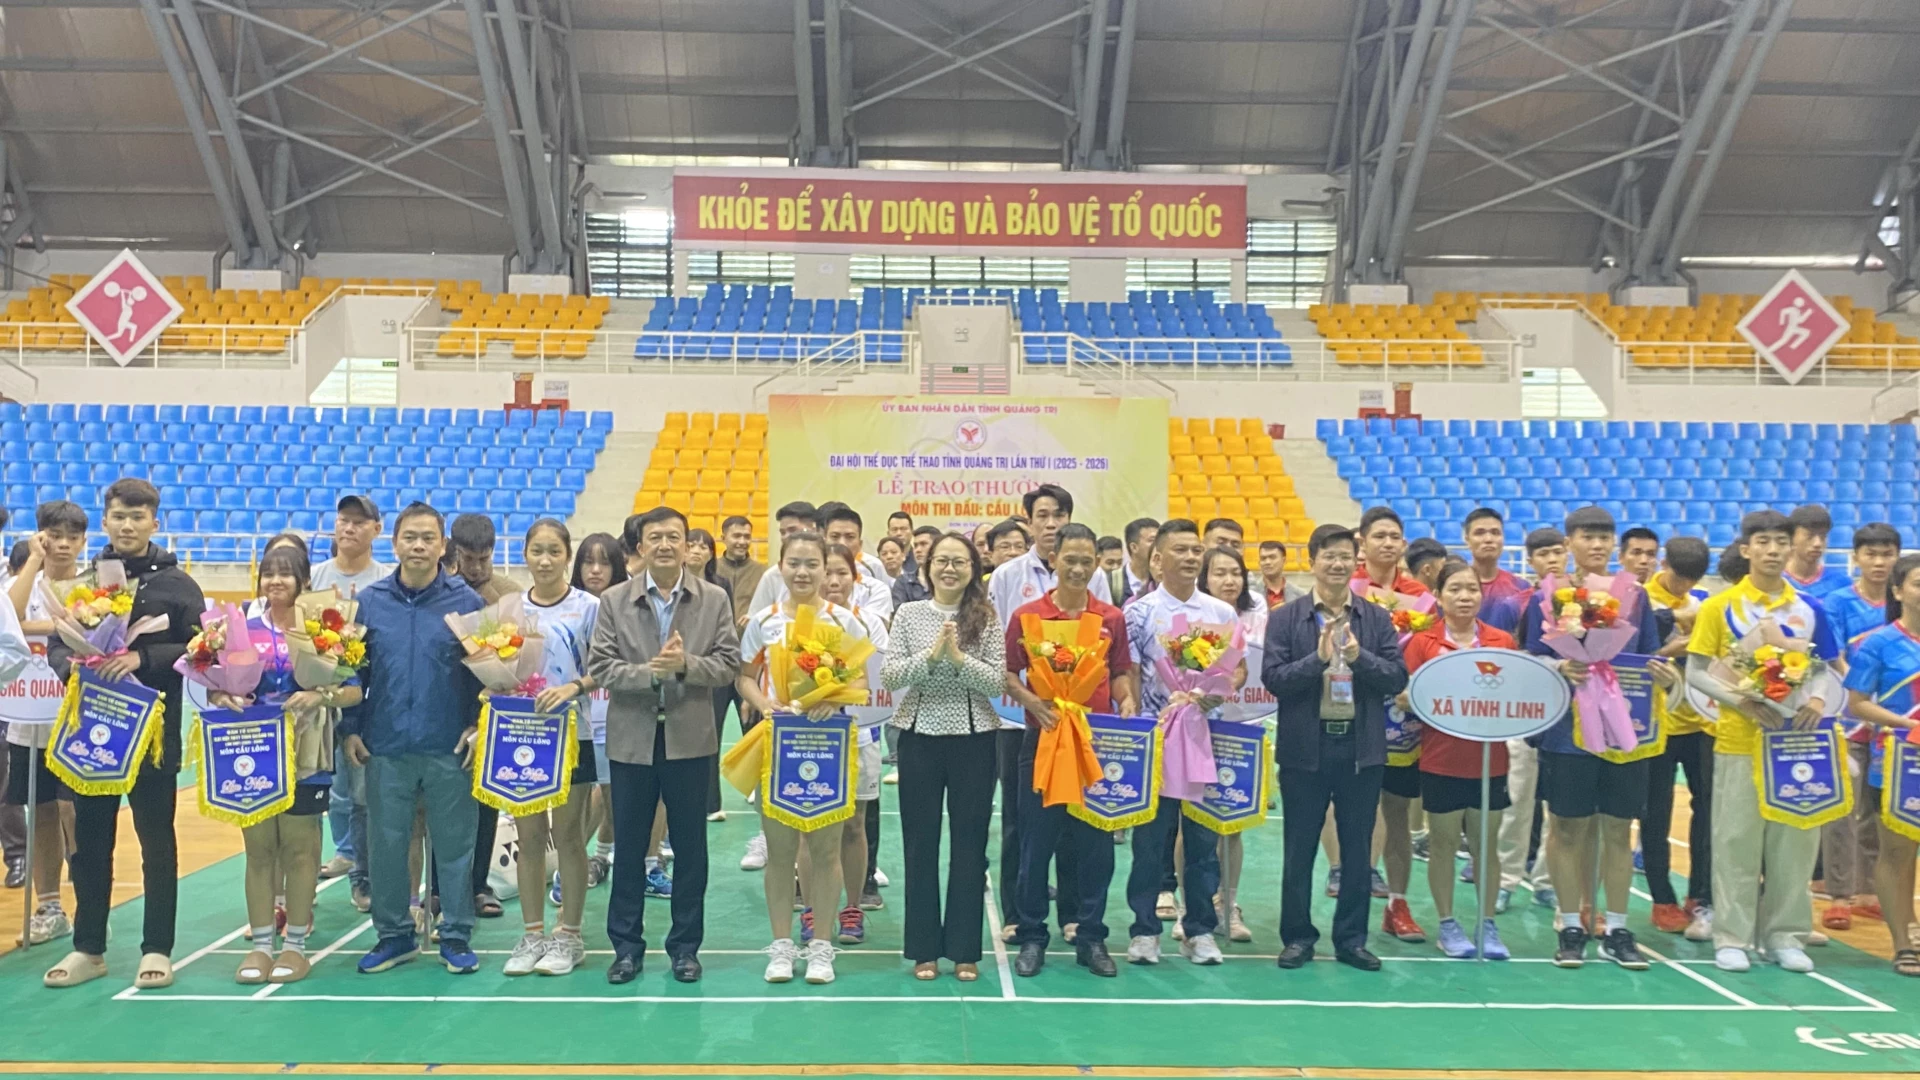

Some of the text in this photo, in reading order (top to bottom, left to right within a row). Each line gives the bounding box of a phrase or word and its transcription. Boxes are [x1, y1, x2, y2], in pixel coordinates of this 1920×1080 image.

[699, 182, 1223, 243] KHỎE ĐỂ XÂY DỰNG VÀ BẢO VỆ TỔ QUỐC
[922, 403, 950, 412] NHÂN
[954, 404, 975, 413] DÂN
[830, 455, 844, 470] ĐẠI
[847, 454, 861, 470] HỘI
[882, 456, 898, 470] DỤC
[919, 455, 939, 468] THAO
[964, 453, 993, 470] QUẢNG
[996, 456, 1009, 471] TRỊ
[1053, 458, 1077, 470] (2025
[877, 472, 903, 495] LỄ
[909, 480, 955, 495] TRAO
[901, 500, 929, 516] MÔN
[932, 503, 951, 516] THI
[31, 672, 65, 700] QUẢN
[1431, 696, 1544, 719] XÃ VĨNH LINH
